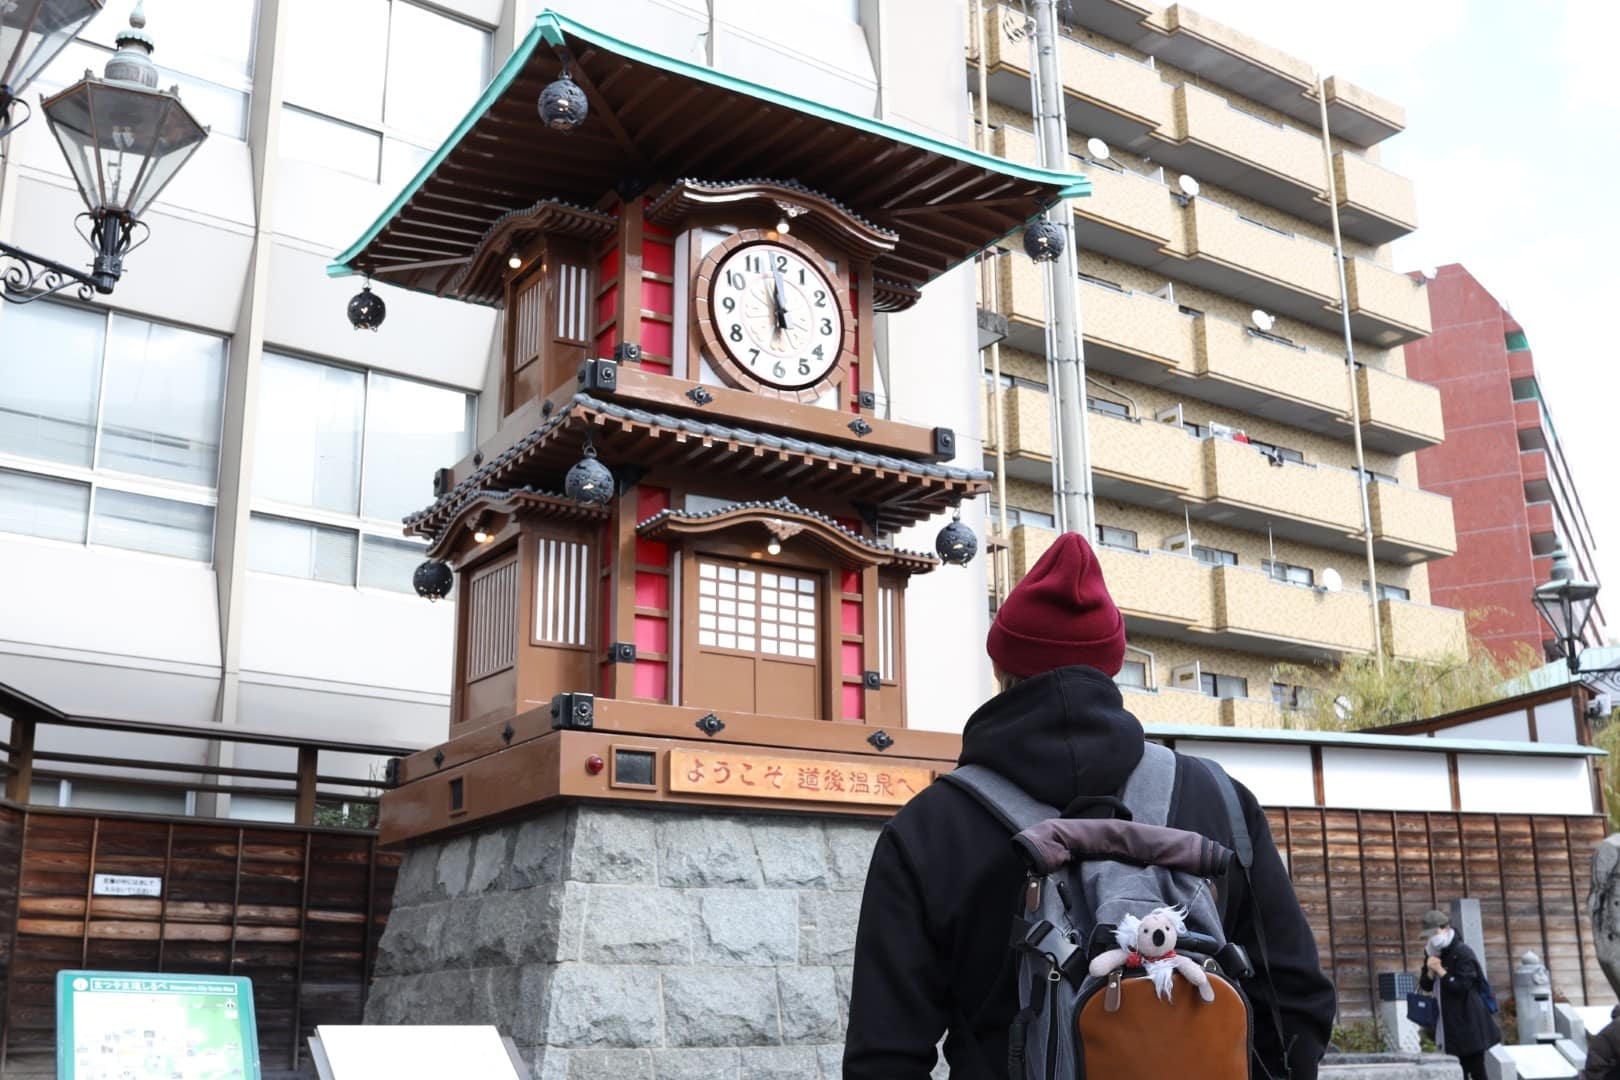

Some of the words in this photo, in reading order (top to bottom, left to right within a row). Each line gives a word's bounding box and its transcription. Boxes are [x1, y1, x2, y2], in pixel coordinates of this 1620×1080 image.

[745, 254, 760, 274] 11
[726, 269, 746, 290] 10
[798, 268, 806, 285] 1
[722, 297, 736, 314] 9
[814, 290, 826, 308] 2
[730, 324, 743, 342] 8
[820, 318, 832, 336] 3
[748, 348, 760, 366] 7
[812, 344, 824, 360] 4
[773, 360, 786, 378] 6
[798, 358, 810, 376] 5
[688, 758, 783, 790] ようこそ
[798, 767, 917, 796] 道後温泉へ
